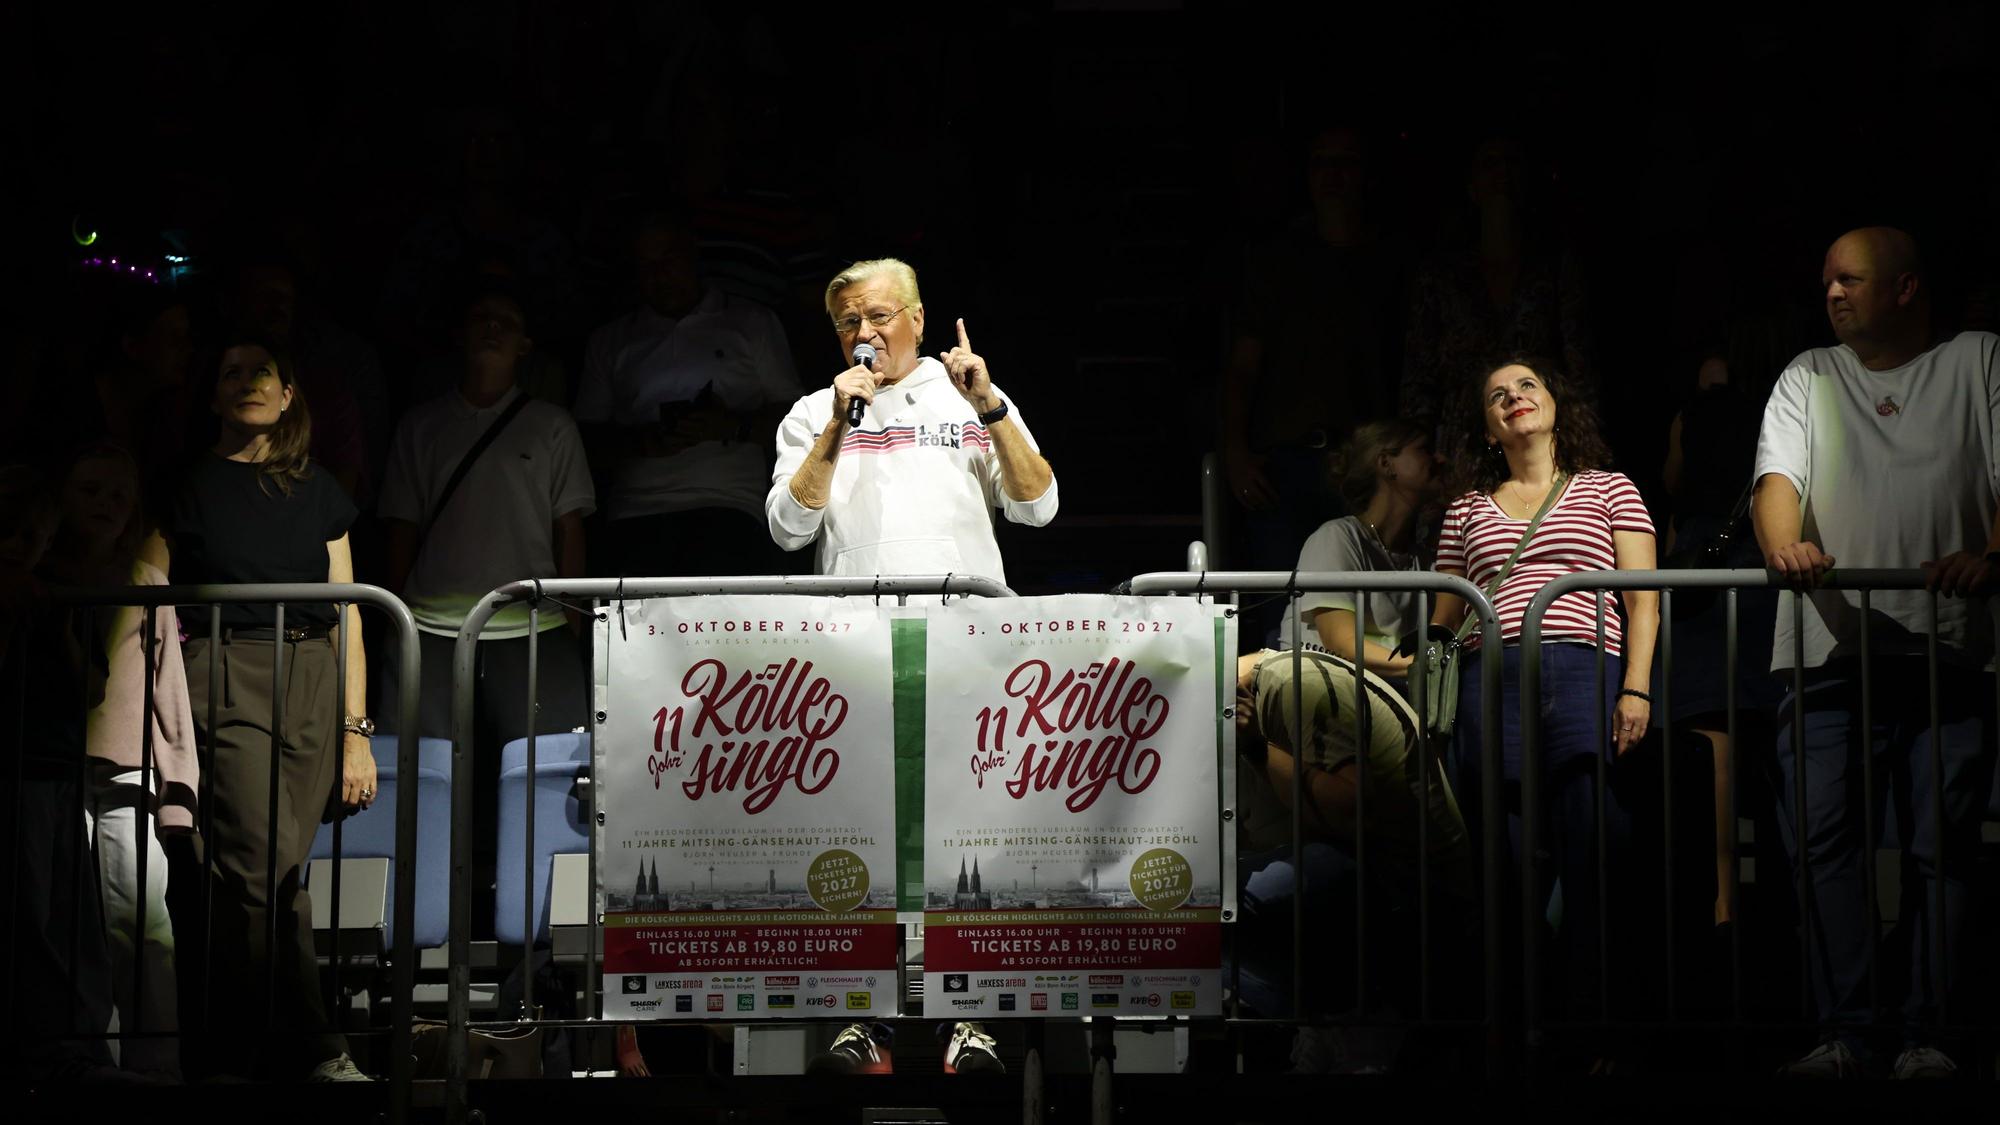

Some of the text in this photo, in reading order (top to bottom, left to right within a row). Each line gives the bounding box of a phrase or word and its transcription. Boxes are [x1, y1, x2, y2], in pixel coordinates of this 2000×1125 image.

[919, 422, 960, 436] 1. FC
[918, 434, 960, 449] KÖLN
[648, 620, 851, 636] 3. OKTOBER 2027
[968, 620, 1173, 636] 3. OKTOBER 2027
[686, 637, 810, 646] LANXESS ARENA
[681, 658, 848, 740] Kölle
[1004, 657, 1170, 740] Kölle
[652, 706, 684, 752] 11
[976, 706, 1008, 752] 11
[682, 718, 840, 814] singt
[1006, 718, 1160, 814] singt
[622, 834, 876, 848] 11 JAHRE MITSING-GÄNSEHAUT-JEFÖHL
[944, 834, 1198, 847] 11 JAHRE MITSING-GÄNSEHAUT-JEFÖHL
[820, 857, 849, 870] JETZT
[1144, 856, 1172, 869] JETZT
[810, 865, 864, 880] TICKETS FÜR
[1132, 864, 1186, 880] TICKETS FÜR
[821, 876, 856, 894] 2027
[1144, 874, 1180, 892] 2027
[820, 890, 862, 904] SICHERN!
[625, 916, 638, 924] DIE
[641, 914, 687, 924] KÖLSCHEN
[690, 914, 742, 923] HIGHLIGHTS
[744, 914, 762, 922] AUS
[773, 914, 837, 922] EMOTIONALEN
[839, 913, 874, 921] JAHREN
[962, 913, 1009, 922] KÖLSCHEN
[1012, 913, 1064, 921] HIGHLIGHTS
[1096, 912, 1160, 920] EMOTIONALEN
[1163, 912, 1198, 920] JAHREN
[636, 930, 681, 939] EINLASS
[684, 930, 710, 938] 16.00
[714, 930, 737, 938] UHR
[758, 929, 799, 938] BEGINN
[803, 928, 832, 937] 18.00
[835, 928, 862, 936] UHR!
[958, 928, 1002, 938] EINLASS
[1006, 928, 1033, 937] 16.00
[1038, 928, 1060, 936] UHR
[1080, 928, 1122, 936] BEGINN
[1127, 927, 1154, 936] 18.00
[1158, 926, 1187, 935] UHR!
[650, 940, 854, 956] TICKETS AB 19,80 EURO
[970, 938, 1177, 954] TICKETS AB 19,80 EURO
[678, 956, 818, 967] AB SOFORT ERHÄLTLICH!
[1002, 957, 1015, 965] AB
[1020, 956, 1064, 965] SOFORT
[655, 980, 703, 990] LANXESS arena
[976, 978, 1026, 988] LANXESS arena
[806, 998, 824, 1006] KVB
[1130, 996, 1148, 1004] KVB
